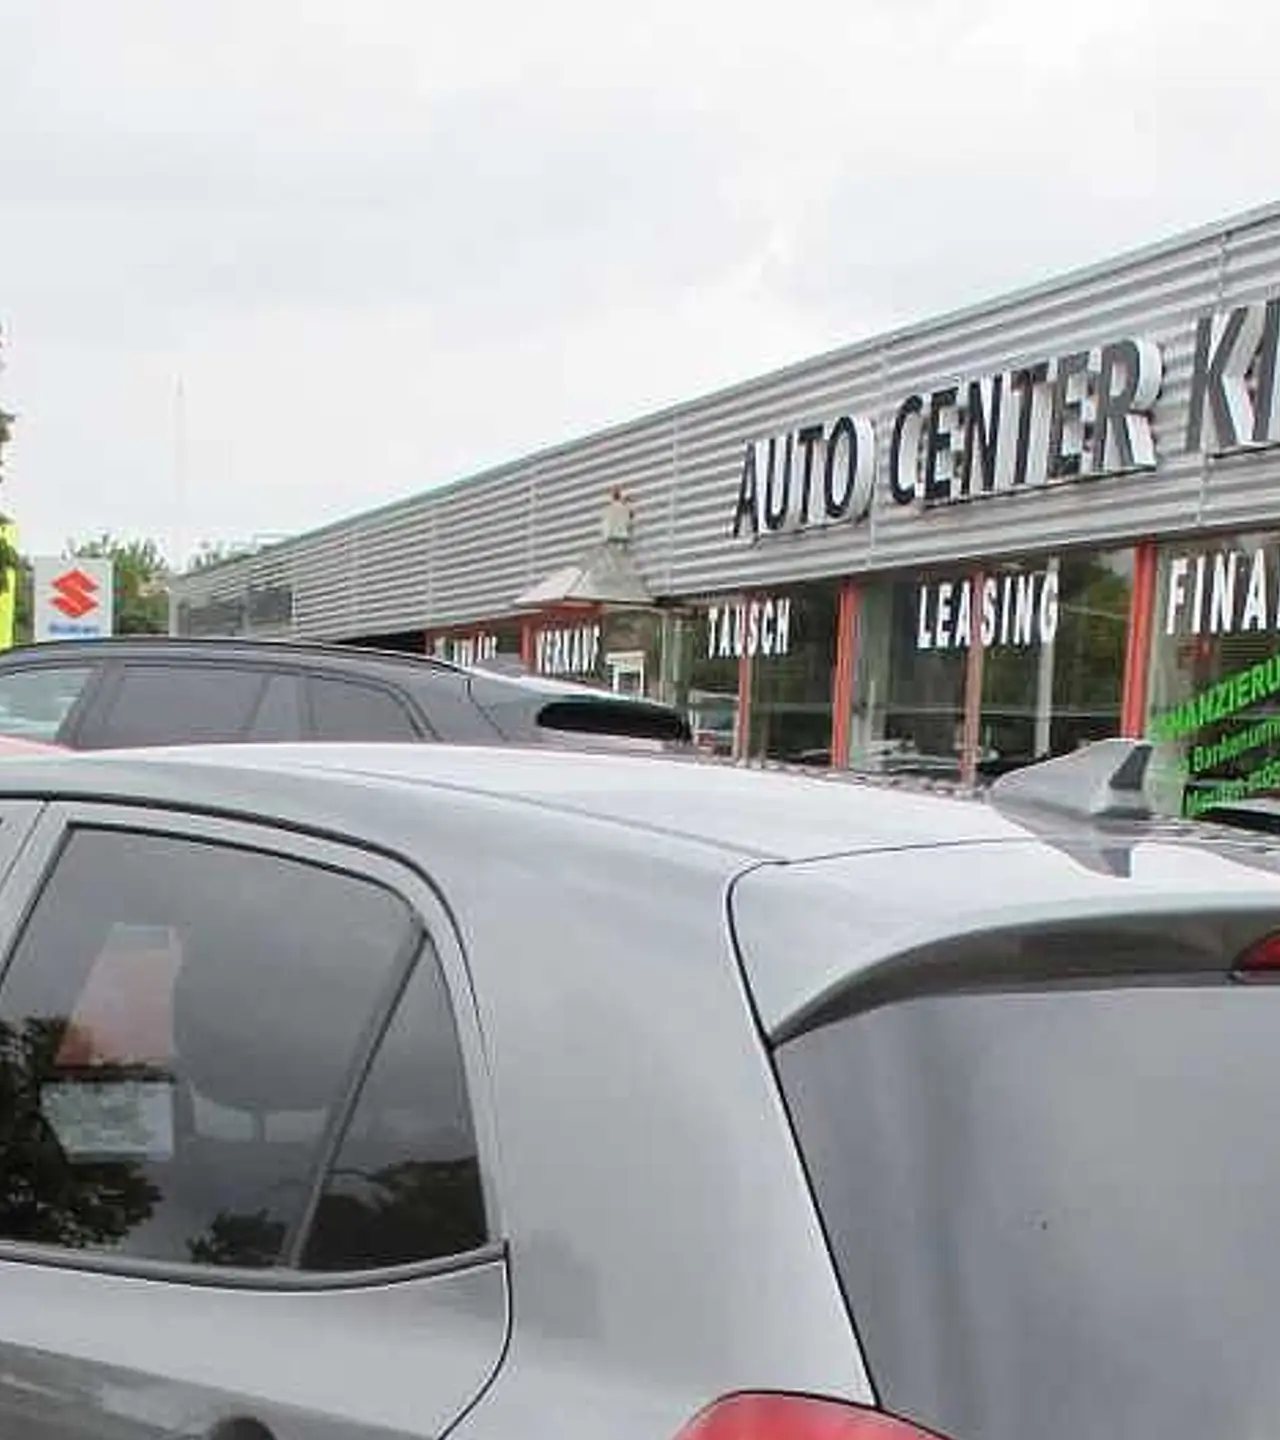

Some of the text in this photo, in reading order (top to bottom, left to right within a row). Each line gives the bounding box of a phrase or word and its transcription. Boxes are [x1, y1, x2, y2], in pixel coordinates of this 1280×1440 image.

[733, 414, 870, 540] AUTO
[890, 336, 1162, 506] CENTER
[707, 596, 792, 660] TAUSCH
[916, 570, 1060, 650] LEASING
